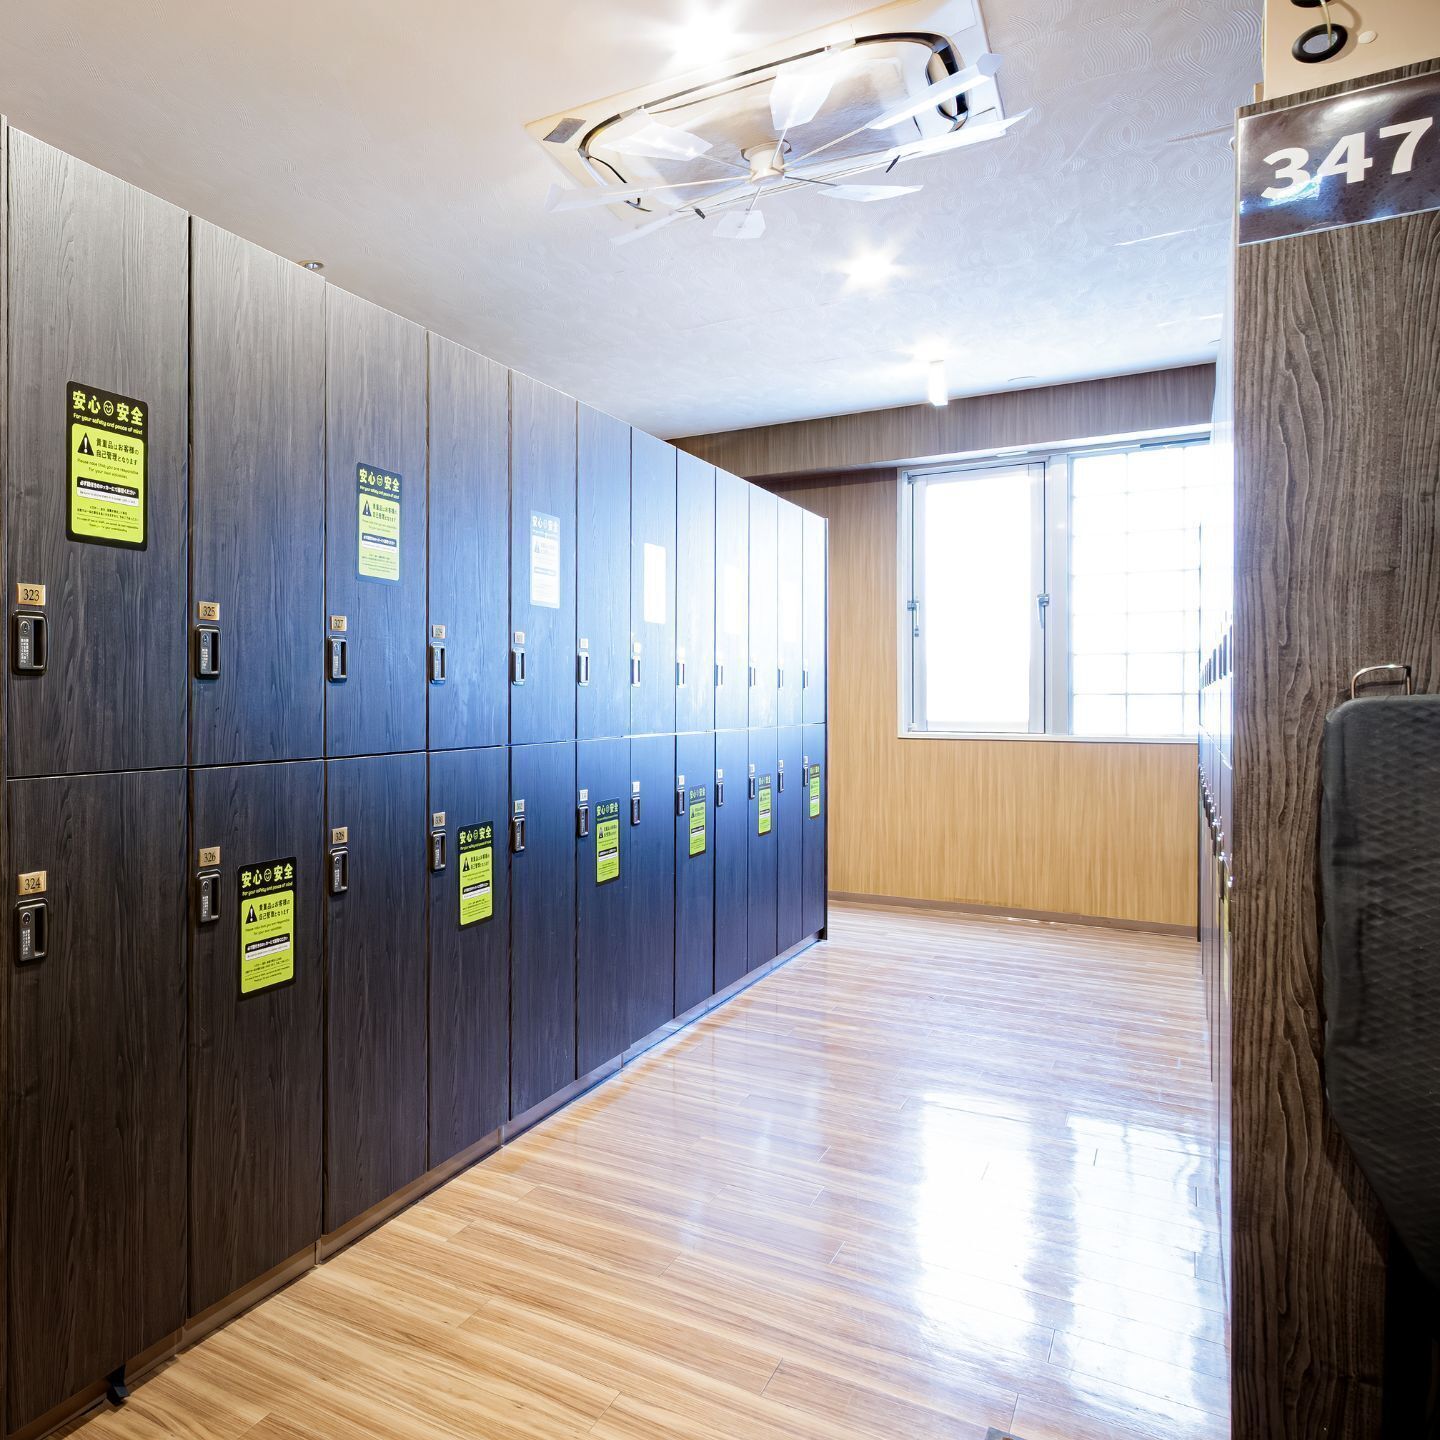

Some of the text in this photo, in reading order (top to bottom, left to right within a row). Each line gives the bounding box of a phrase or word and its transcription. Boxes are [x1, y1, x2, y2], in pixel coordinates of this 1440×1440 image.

[1261, 116, 1433, 200] 347
[72, 390, 143, 427] 安心 安全
[24, 588, 40, 601] 323
[202, 606, 215, 617] 325
[334, 619, 344, 627] 327
[336, 832, 344, 841] 328
[204, 852, 216, 862] 326
[242, 862, 294, 888] 安心 安全
[24, 877, 41, 890] 324
